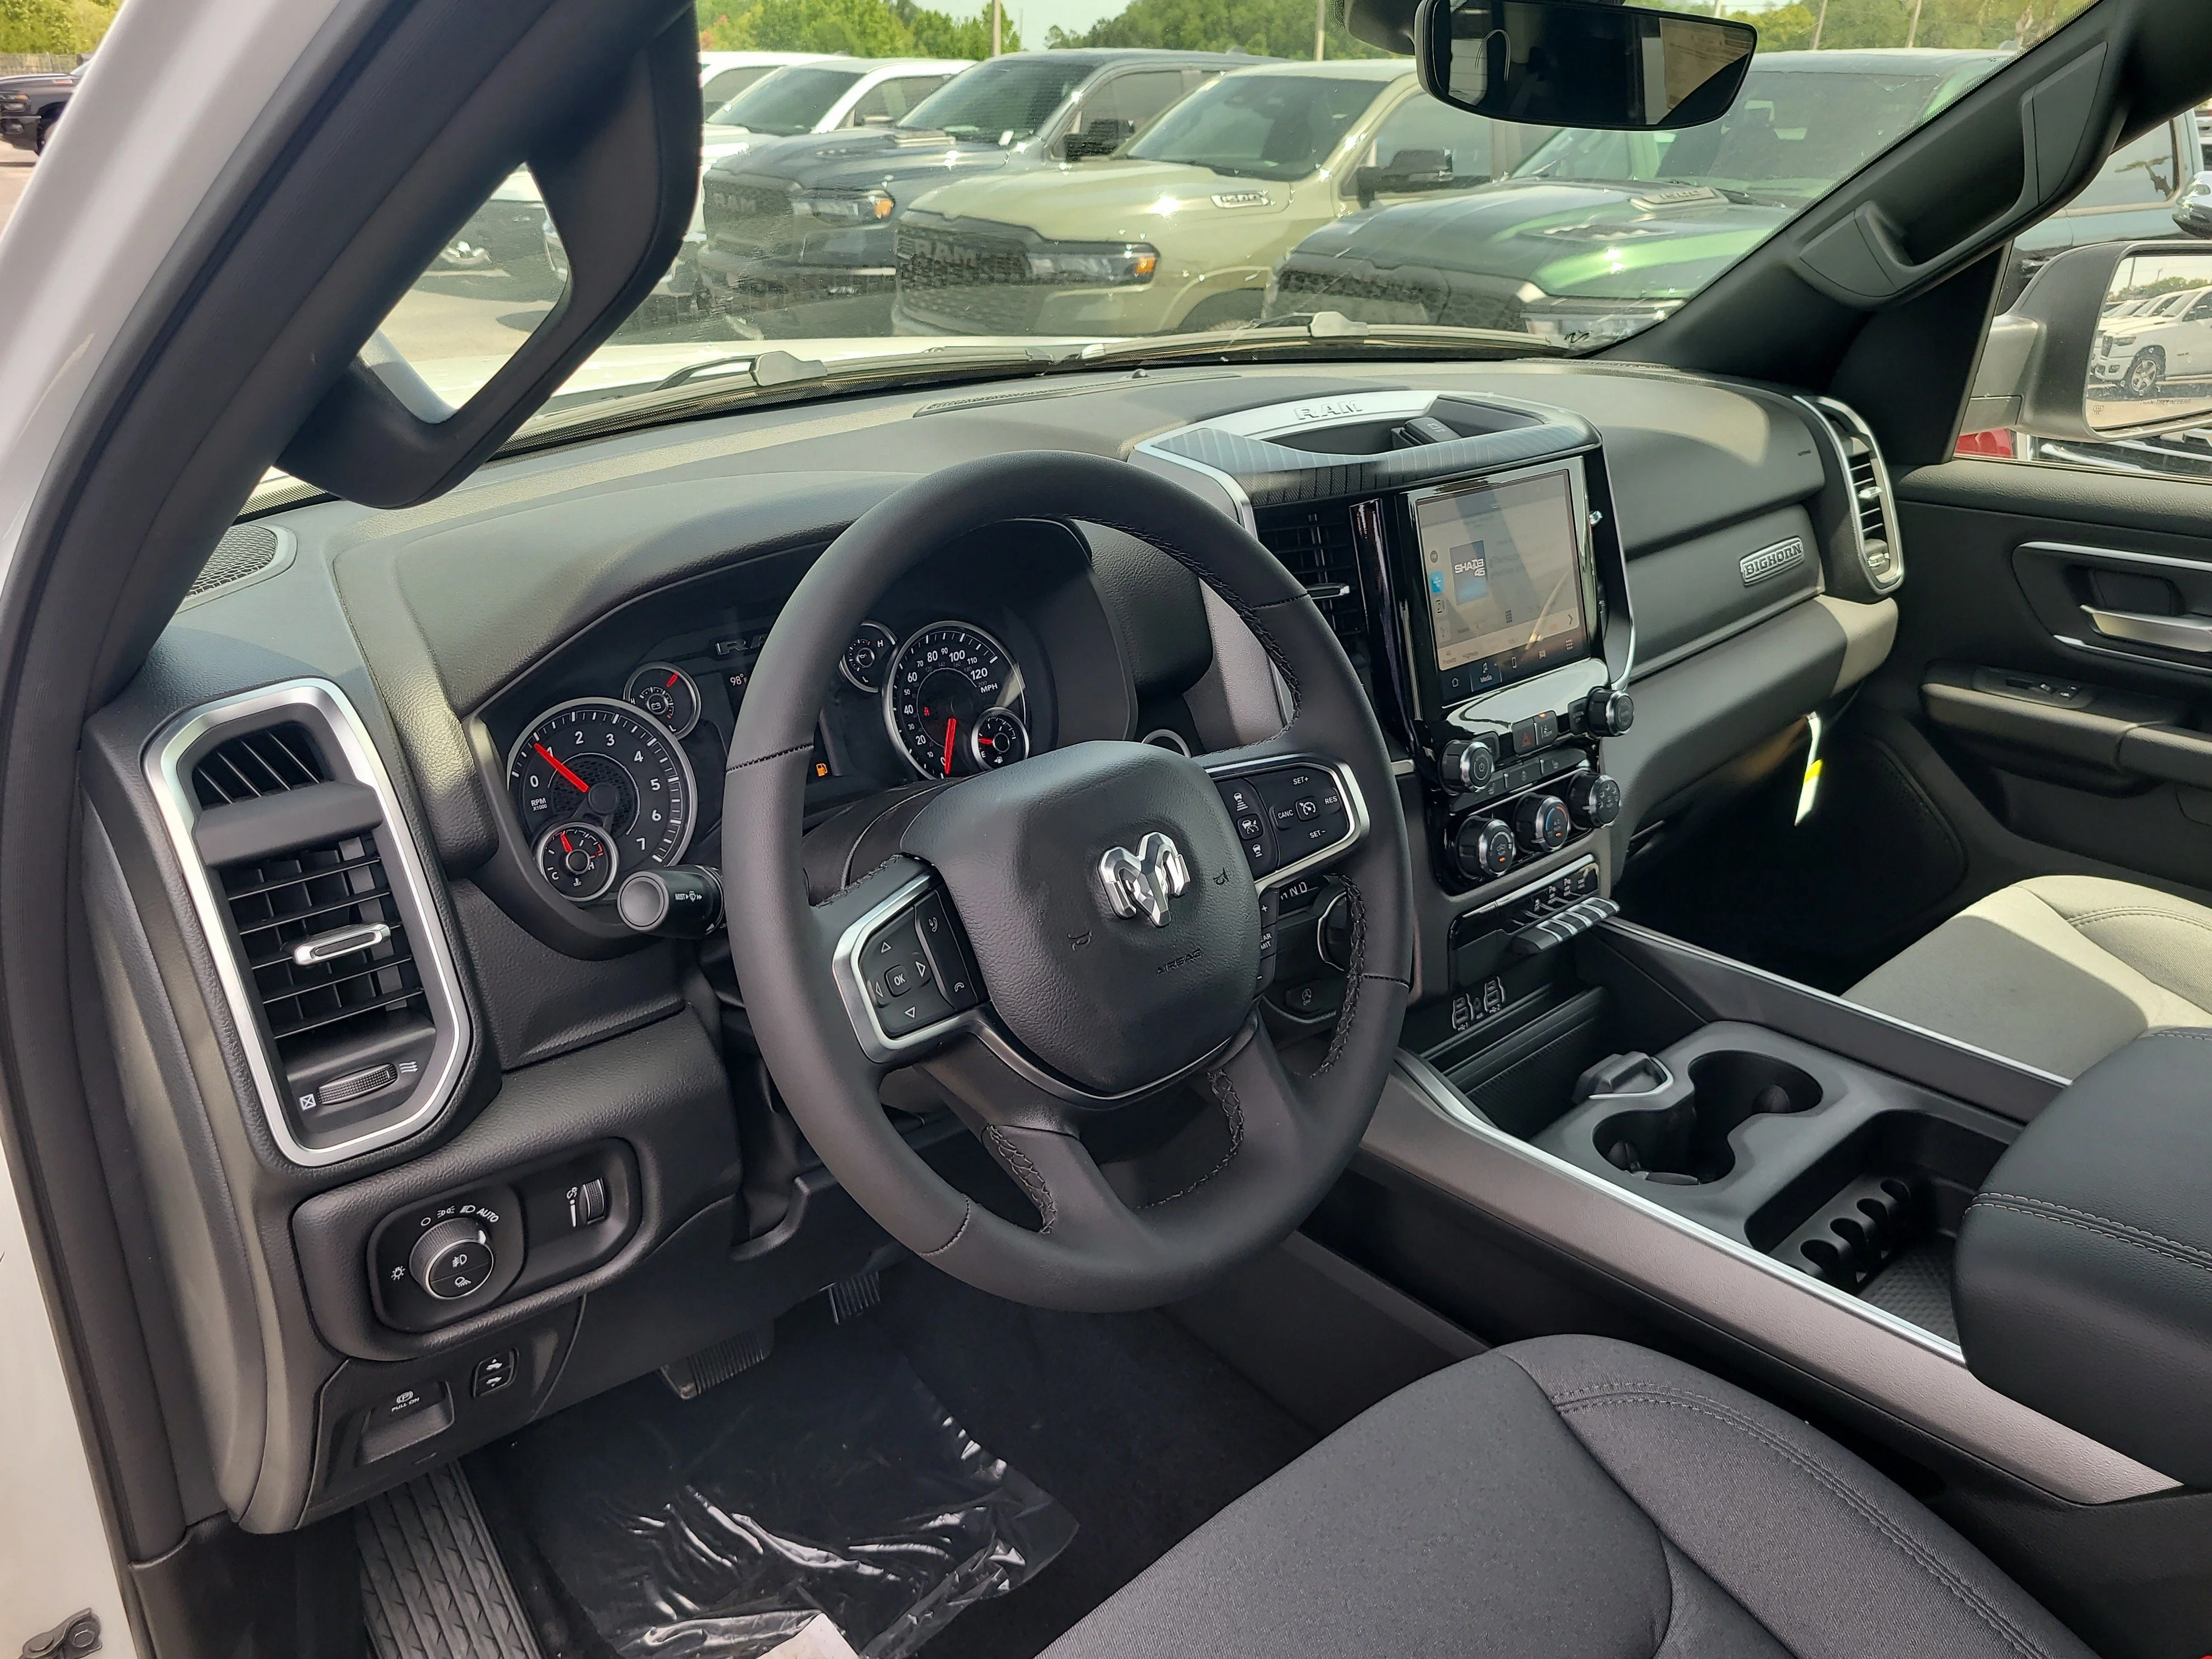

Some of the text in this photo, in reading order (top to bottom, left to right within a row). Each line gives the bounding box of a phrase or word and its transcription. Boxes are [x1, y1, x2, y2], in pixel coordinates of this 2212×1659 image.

[1294, 399, 1363, 420] RAM
[1454, 558, 1484, 573] SHADE
[1475, 567, 1485, 576] 45
[715, 635, 768, 656] RA
[927, 651, 938, 662] 80
[949, 650, 966, 662] 100
[967, 657, 978, 665] 110
[907, 672, 917, 682] 60
[970, 667, 988, 680] 120
[980, 683, 998, 693] MPH
[904, 704, 913, 715] 40
[574, 731, 584, 744] 2
[606, 733, 615, 746] 3
[915, 735, 926, 746] 20
[634, 751, 644, 763] 4
[530, 776, 539, 787] 0
[650, 778, 661, 791] 5
[531, 797, 546, 807] RPM
[1324, 795, 1338, 805] RES
[652, 809, 662, 821] 6
[1278, 809, 1294, 820] CANC
[636, 838, 646, 850] 7
[552, 871, 560, 881] C
[1289, 886, 1298, 897] N
[1299, 882, 1307, 893] D
[1260, 933, 1272, 942] EAR
[1156, 947, 1203, 975] AIRBAG
[894, 974, 906, 986] OK
[476, 1207, 499, 1223] AUTO
[391, 1397, 420, 1413] PULL ON
